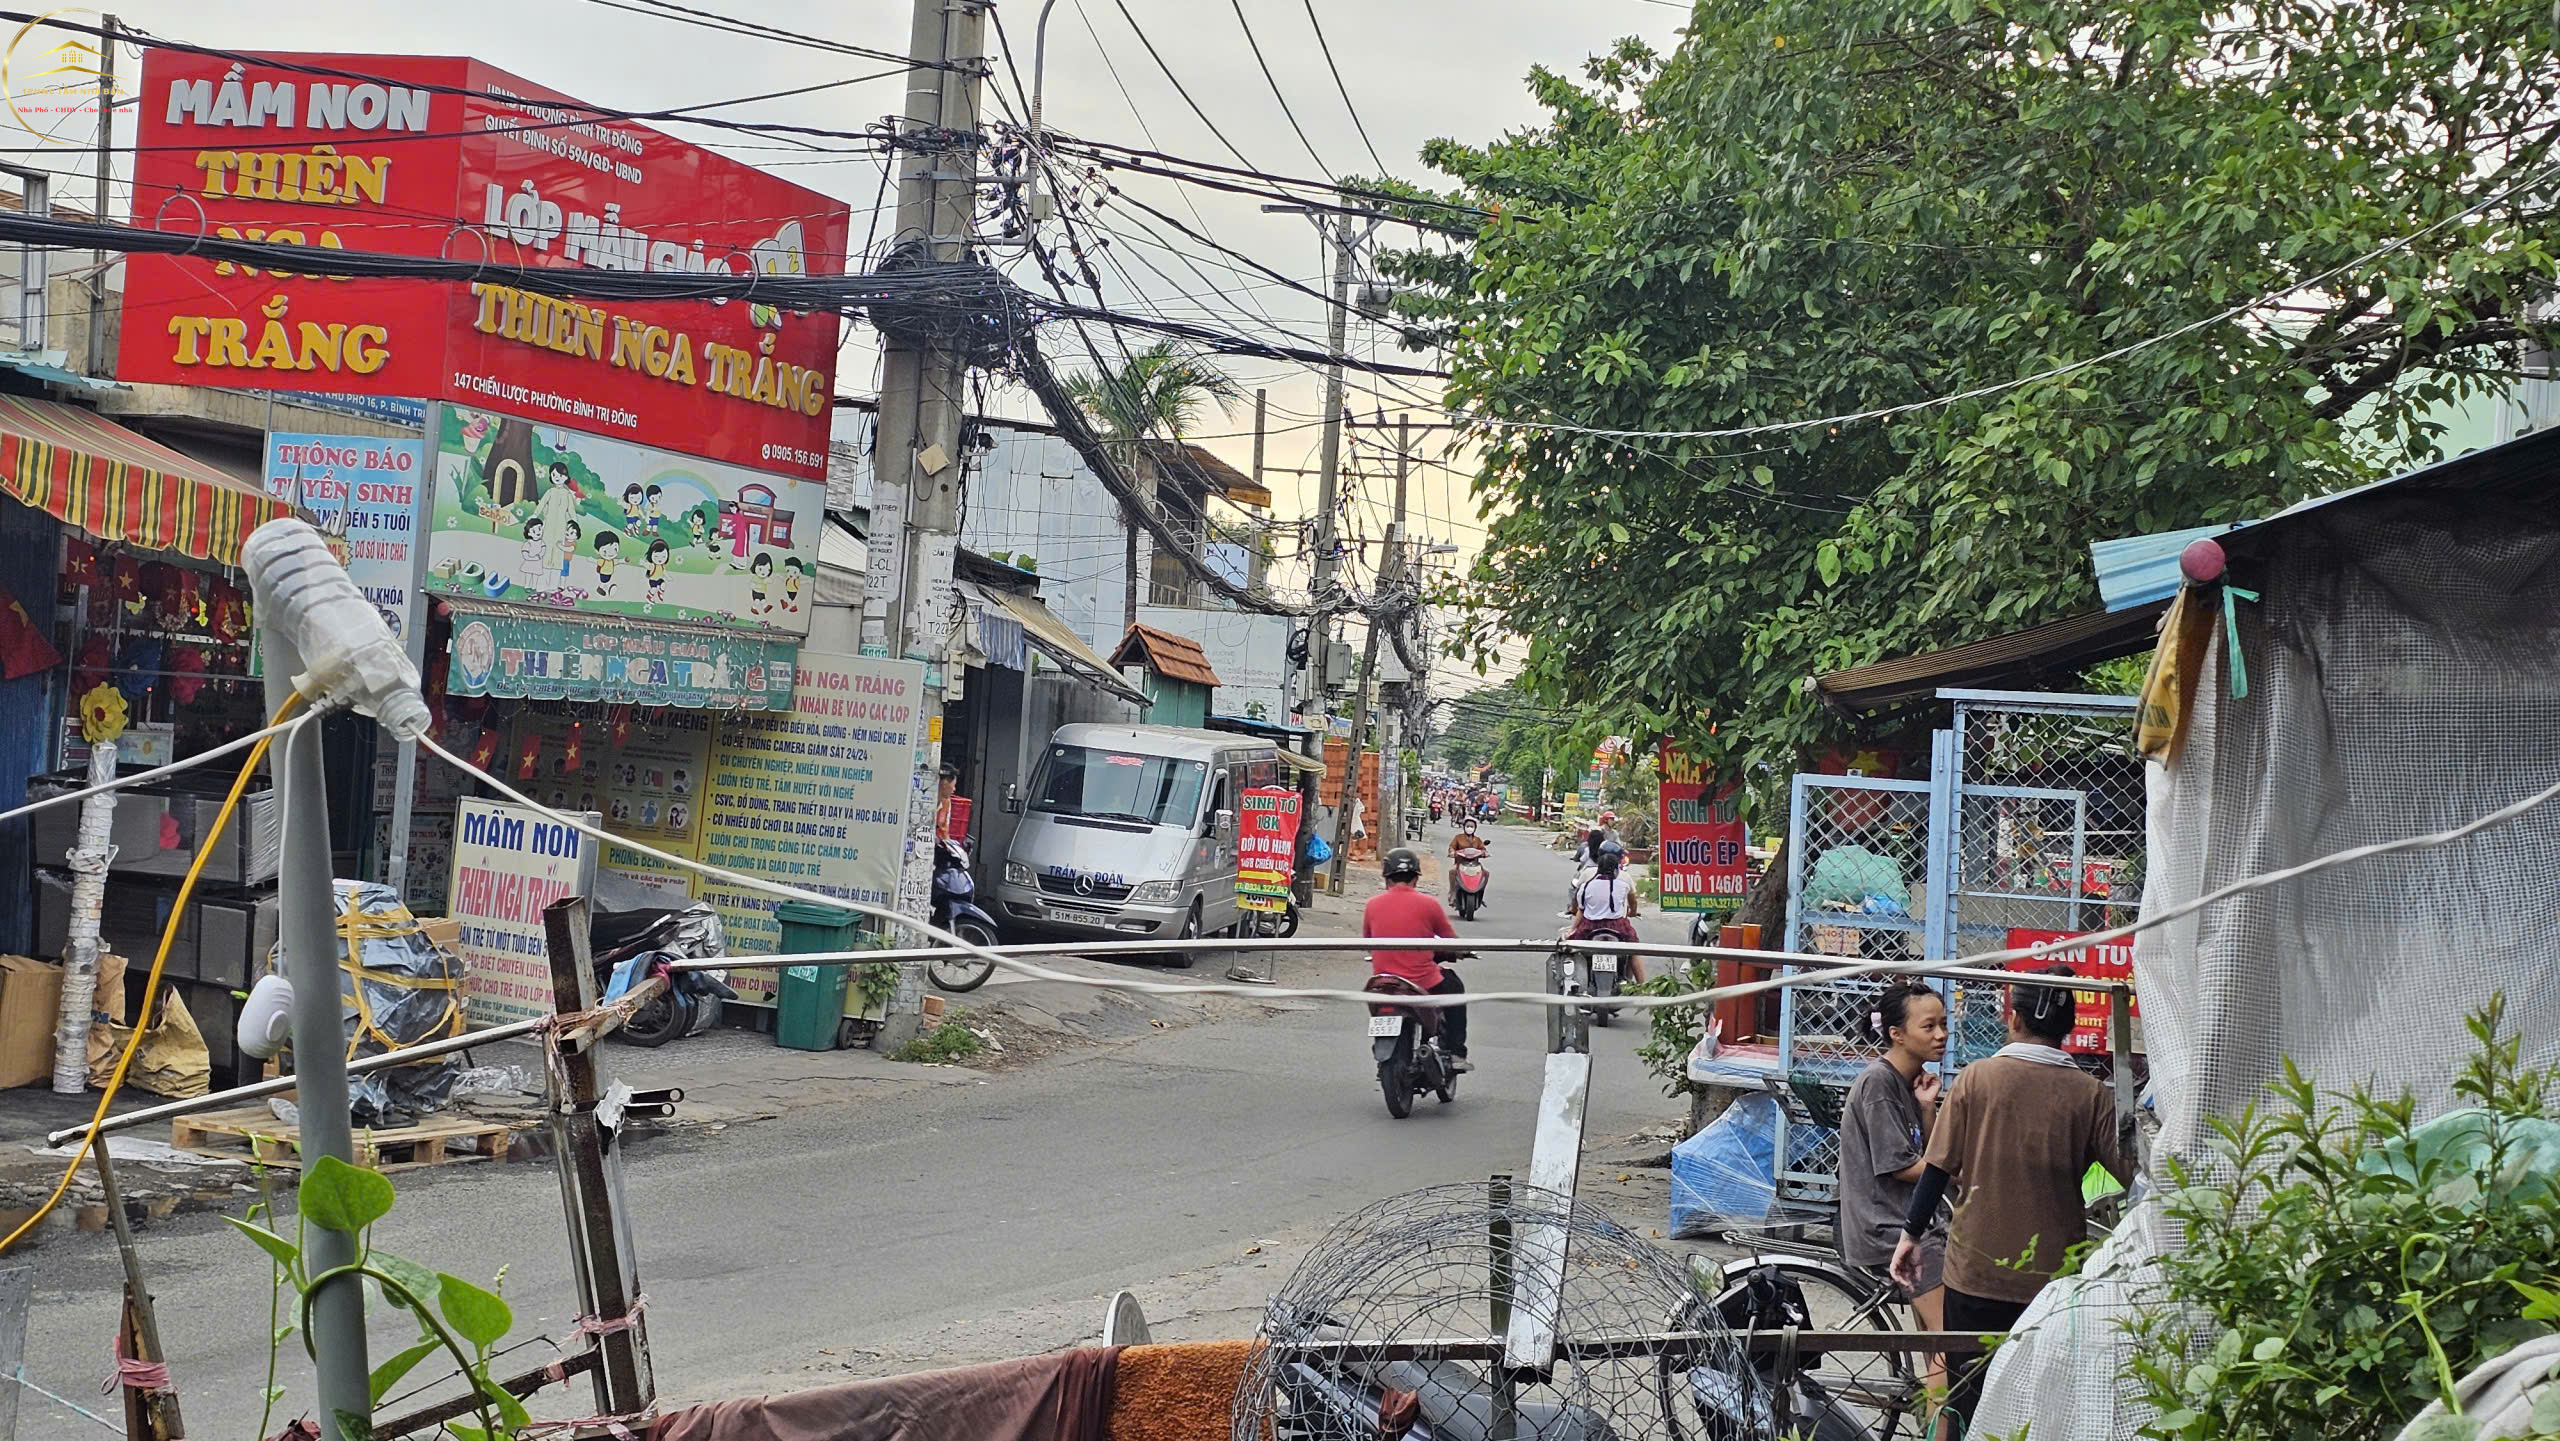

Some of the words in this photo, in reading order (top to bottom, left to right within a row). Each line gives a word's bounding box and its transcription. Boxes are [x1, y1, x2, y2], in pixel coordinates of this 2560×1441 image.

[165, 62, 295, 128] MẦM
[306, 82, 430, 131] NON
[611, 130, 643, 156] ĐÔNG
[522, 129, 550, 152] ĐỊNH
[551, 135, 568, 158] SỐ
[615, 160, 643, 185] UBND
[196, 144, 392, 205] THIÊN
[484, 179, 563, 251] LỚP
[564, 202, 648, 272] MẪU
[168, 294, 391, 375] TRẮNG
[610, 315, 697, 385] NGA
[704, 332, 825, 416] TRẮNG
[390, 400, 411, 415] BÌNH
[453, 372, 472, 389] 147
[472, 375, 500, 397] CHIẾN
[501, 383, 529, 406] LƯỢC
[530, 391, 571, 414] PHƯỜNG
[573, 398, 594, 419] BÌNH
[596, 405, 610, 426] TRỊ
[611, 408, 638, 428] ĐÔNG
[278, 441, 358, 467] THÔNG
[364, 446, 412, 471] BÁO
[771, 444, 824, 469] 0905.156.691
[272, 469, 351, 499] TYỂN
[357, 483, 413, 504] SINH
[372, 513, 379, 527] 5
[383, 508, 410, 531] TUỔI
[479, 506, 511, 524] School
[433, 556, 510, 598] EDU
[607, 655, 669, 686] NGA
[817, 672, 849, 691] NGA
[855, 670, 905, 696] TRẮNG
[800, 695, 829, 718] NHẬN
[846, 698, 867, 719] VÀO
[883, 731, 896, 744] CHO
[773, 740, 805, 754] CAMERA
[807, 741, 828, 757] GIÁM
[829, 744, 845, 759] SÁT
[846, 748, 868, 761] 24/24
[720, 754, 731, 766] GV
[731, 755, 762, 769] CHUYÊN
[821, 765, 840, 778] KINH
[841, 766, 873, 783] NGHIỆM
[717, 772, 738, 787] LUÔN
[740, 775, 754, 789] YÊU
[774, 778, 791, 792] TÂM
[793, 780, 817, 796] HUYẾT
[715, 793, 735, 808] CSVC,
[773, 799, 796, 814] TRANG
[798, 800, 817, 816] THIẾT
[828, 806, 842, 821] DẠY
[844, 805, 854, 820] VÀ
[855, 809, 870, 824] HỌC
[1243, 796, 1275, 811] SINH
[1280, 797, 1296, 813] TỐ
[1668, 798, 1709, 825] SINH
[463, 809, 525, 851] MẦM
[532, 822, 579, 859] NON
[712, 811, 723, 825] CÓ
[762, 819, 781, 832] CHƠI
[782, 821, 793, 833] ĐA
[795, 822, 817, 837] DẠNG
[819, 825, 835, 838] CHO
[836, 825, 847, 839] BÉ
[1257, 815, 1280, 830] 18K
[710, 832, 731, 847] LUÔN
[733, 834, 749, 848] CHÚ
[751, 837, 776, 853] TRỌNG
[777, 839, 799, 854] CÔNG
[801, 841, 816, 855] TÁC
[1240, 834, 1256, 852] DỜI
[1257, 835, 1270, 852] VÔ
[1666, 836, 1712, 866] NƯỚC
[1717, 836, 1740, 866] ÉP
[707, 852, 727, 866] NUÔI
[757, 856, 767, 870] VÀ
[769, 858, 787, 872] GIÁO
[788, 862, 805, 877] DỤC
[807, 860, 821, 876] TRẺ
[456, 856, 495, 918] THIÊN
[493, 872, 524, 922] NGA
[838, 884, 850, 899] CỦA
[861, 889, 870, 901] GD
[871, 888, 880, 903] VÀ
[1664, 869, 1684, 893] DỜI
[1686, 870, 1702, 893] VÔ
[1708, 874, 1743, 894] 146/8
[717, 892, 730, 907] TRẺ
[729, 914, 741, 927] CÁC
[744, 916, 760, 933] HOẠT
[761, 917, 780, 933] ĐỘNG
[738, 937, 774, 953] AEROBIC,
[497, 957, 525, 976] CHUYÊN
[526, 961, 548, 982] LUYỆN
[484, 978, 498, 995] CHO
[500, 978, 513, 997] TRẺ
[515, 981, 528, 1000] VÀO
[530, 983, 544, 1001] LỚP
[748, 977, 759, 991] CÓ
[761, 980, 778, 993] NHU
[2075, 1032, 2099, 1050] HỆ
